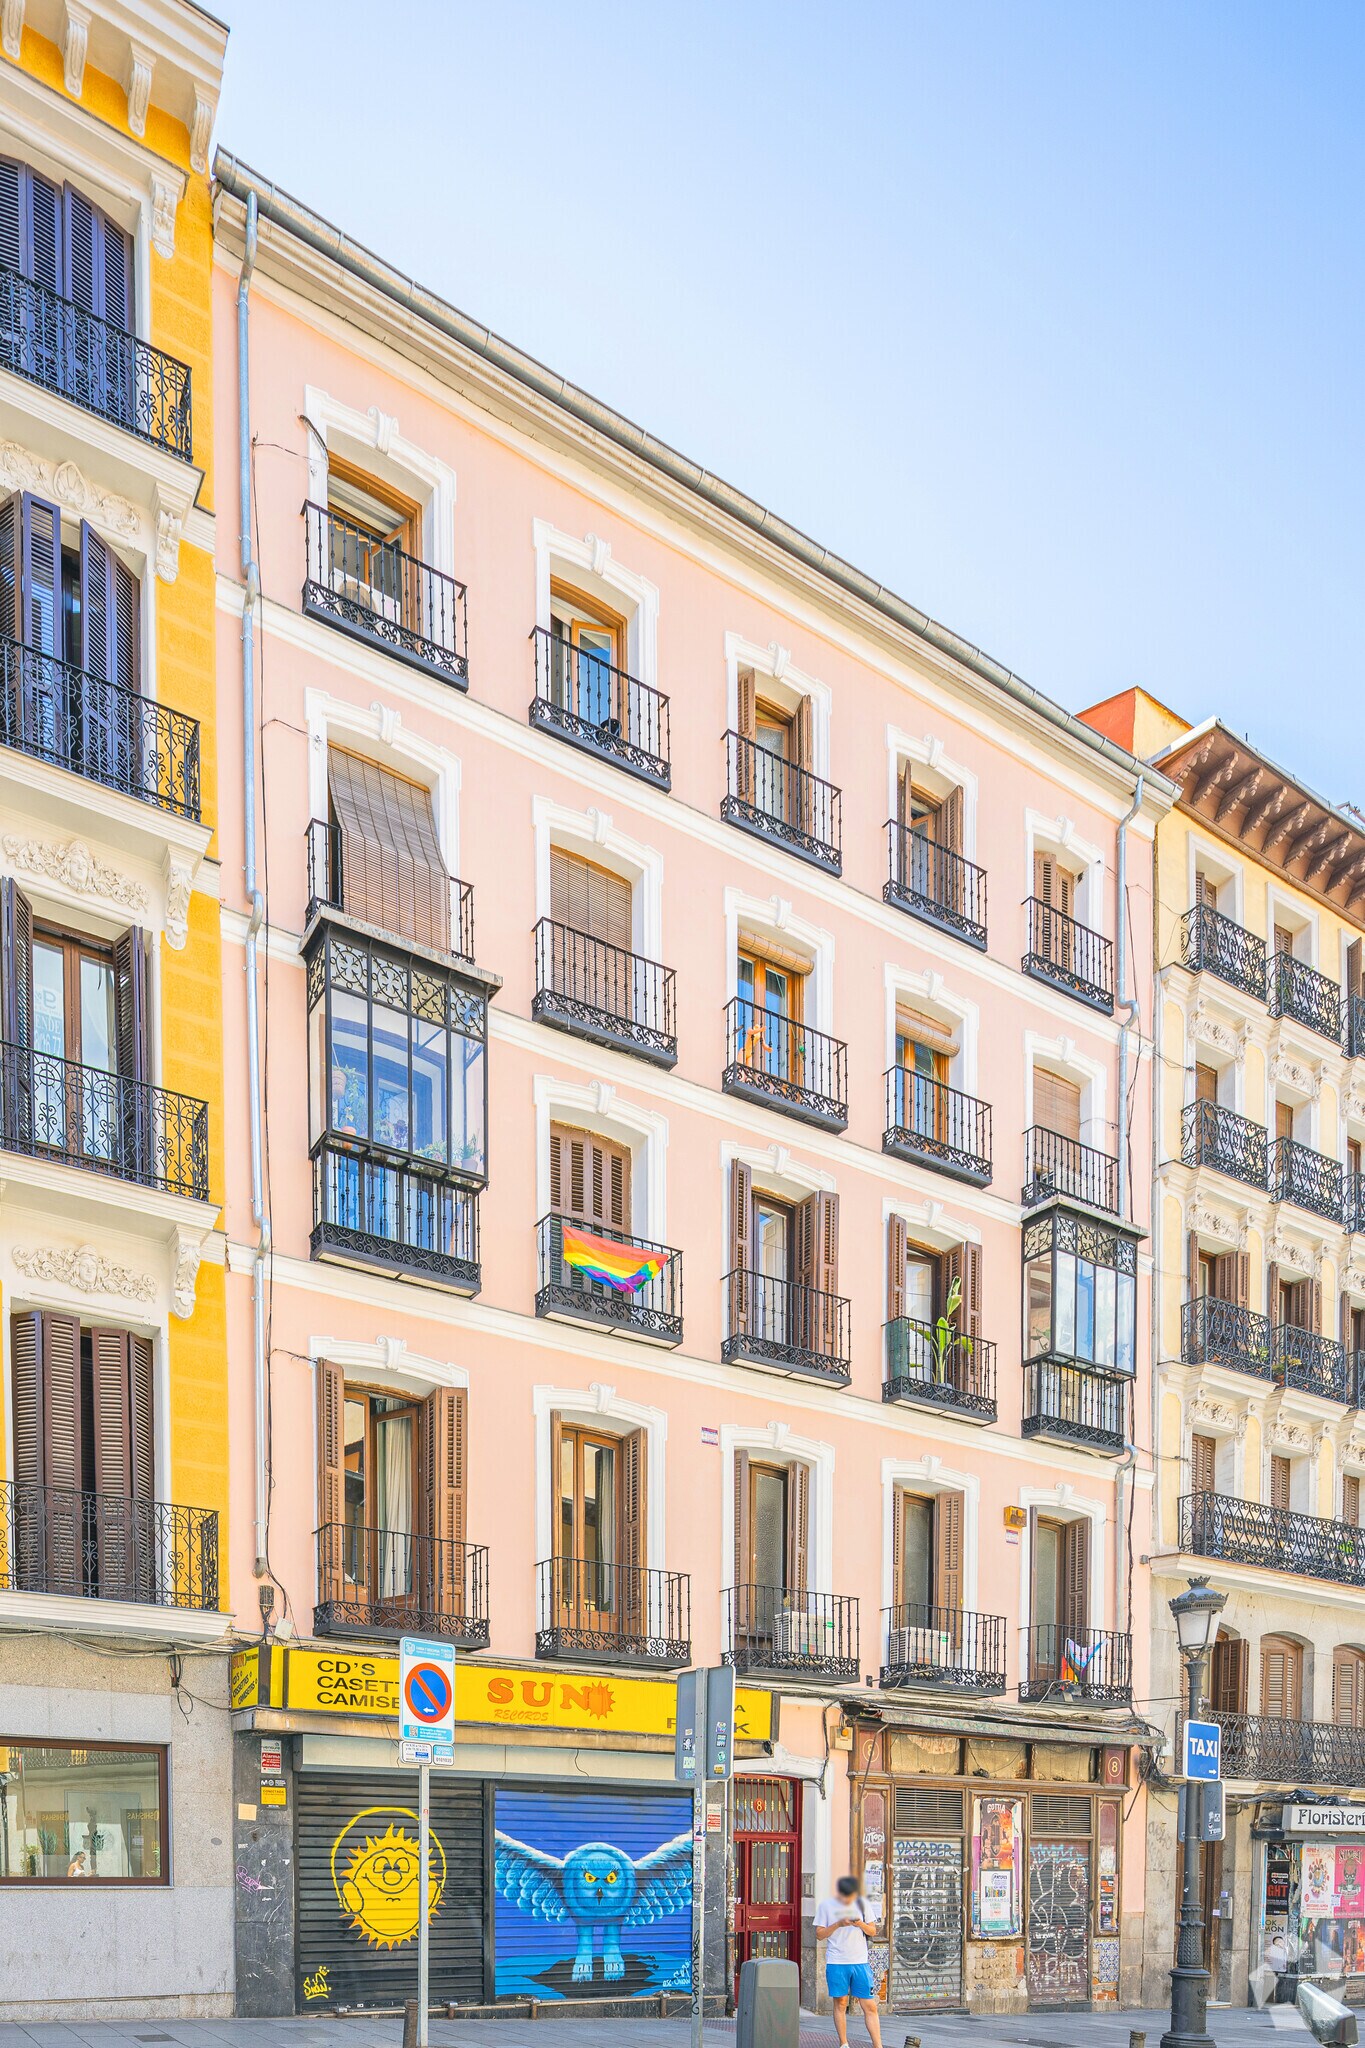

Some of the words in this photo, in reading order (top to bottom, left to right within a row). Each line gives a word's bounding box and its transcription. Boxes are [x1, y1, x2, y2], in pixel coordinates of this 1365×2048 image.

[317, 1660, 375, 1676] CD'S
[487, 1678, 594, 1711] SUN
[493, 1709, 549, 1721] RECORDS
[1190, 1737, 1218, 1758] TAXI
[1111, 1761, 1118, 1773] 8
[756, 1800, 763, 1811] 8
